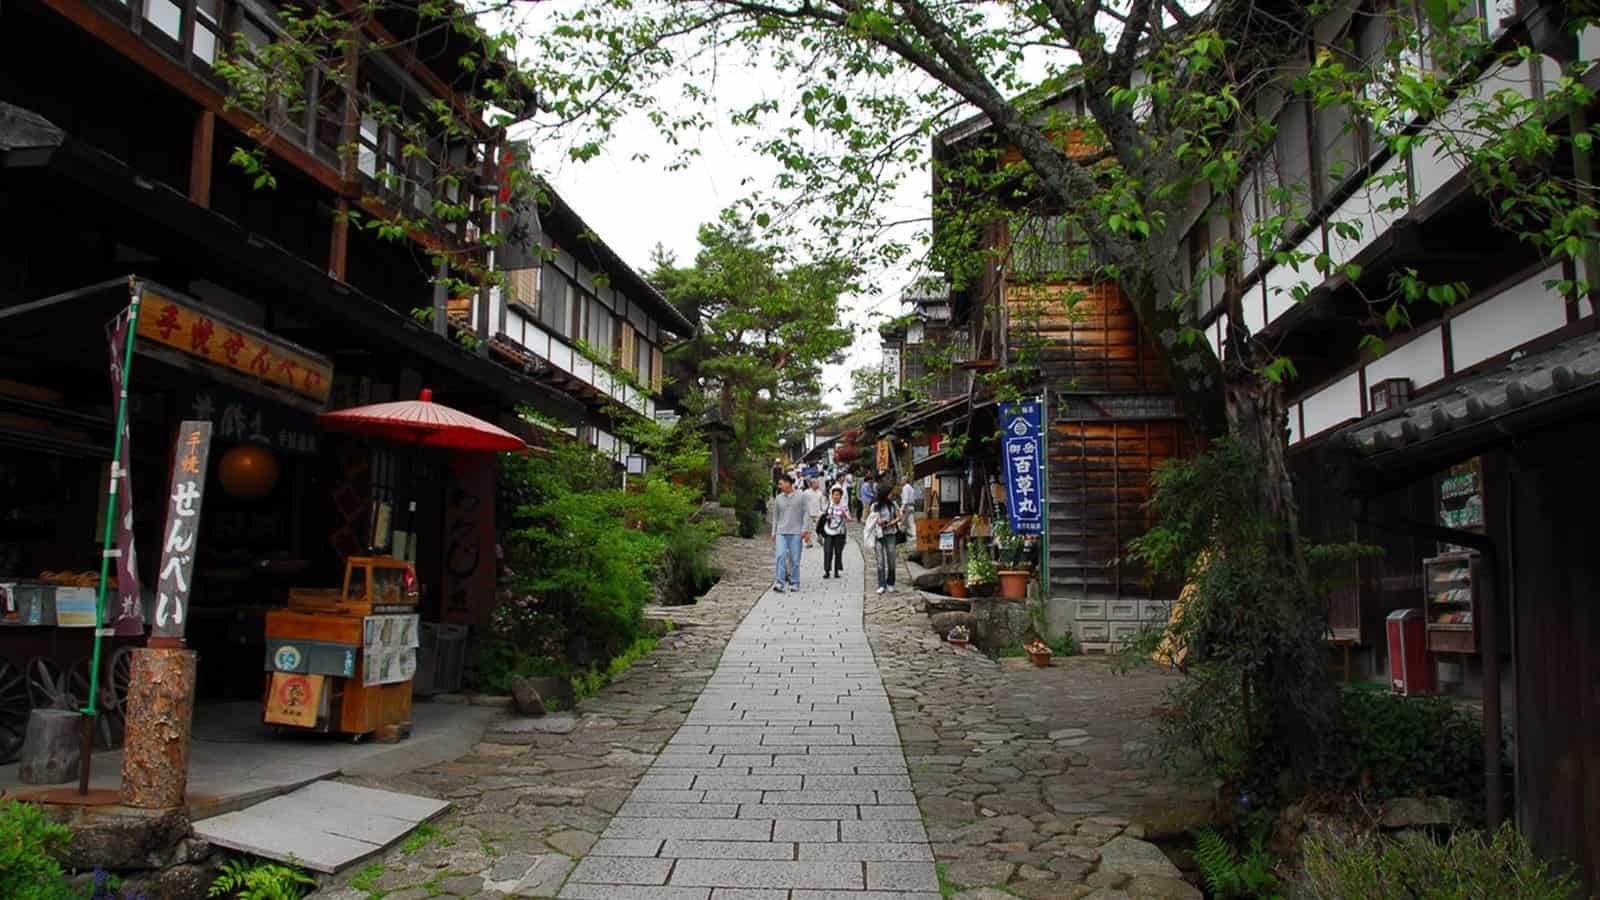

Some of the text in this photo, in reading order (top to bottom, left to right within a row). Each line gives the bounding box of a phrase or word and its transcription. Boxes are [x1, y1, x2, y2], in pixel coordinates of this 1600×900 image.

[1012, 455, 1037, 513] 百草丸
[156, 481, 201, 628] せんべい
